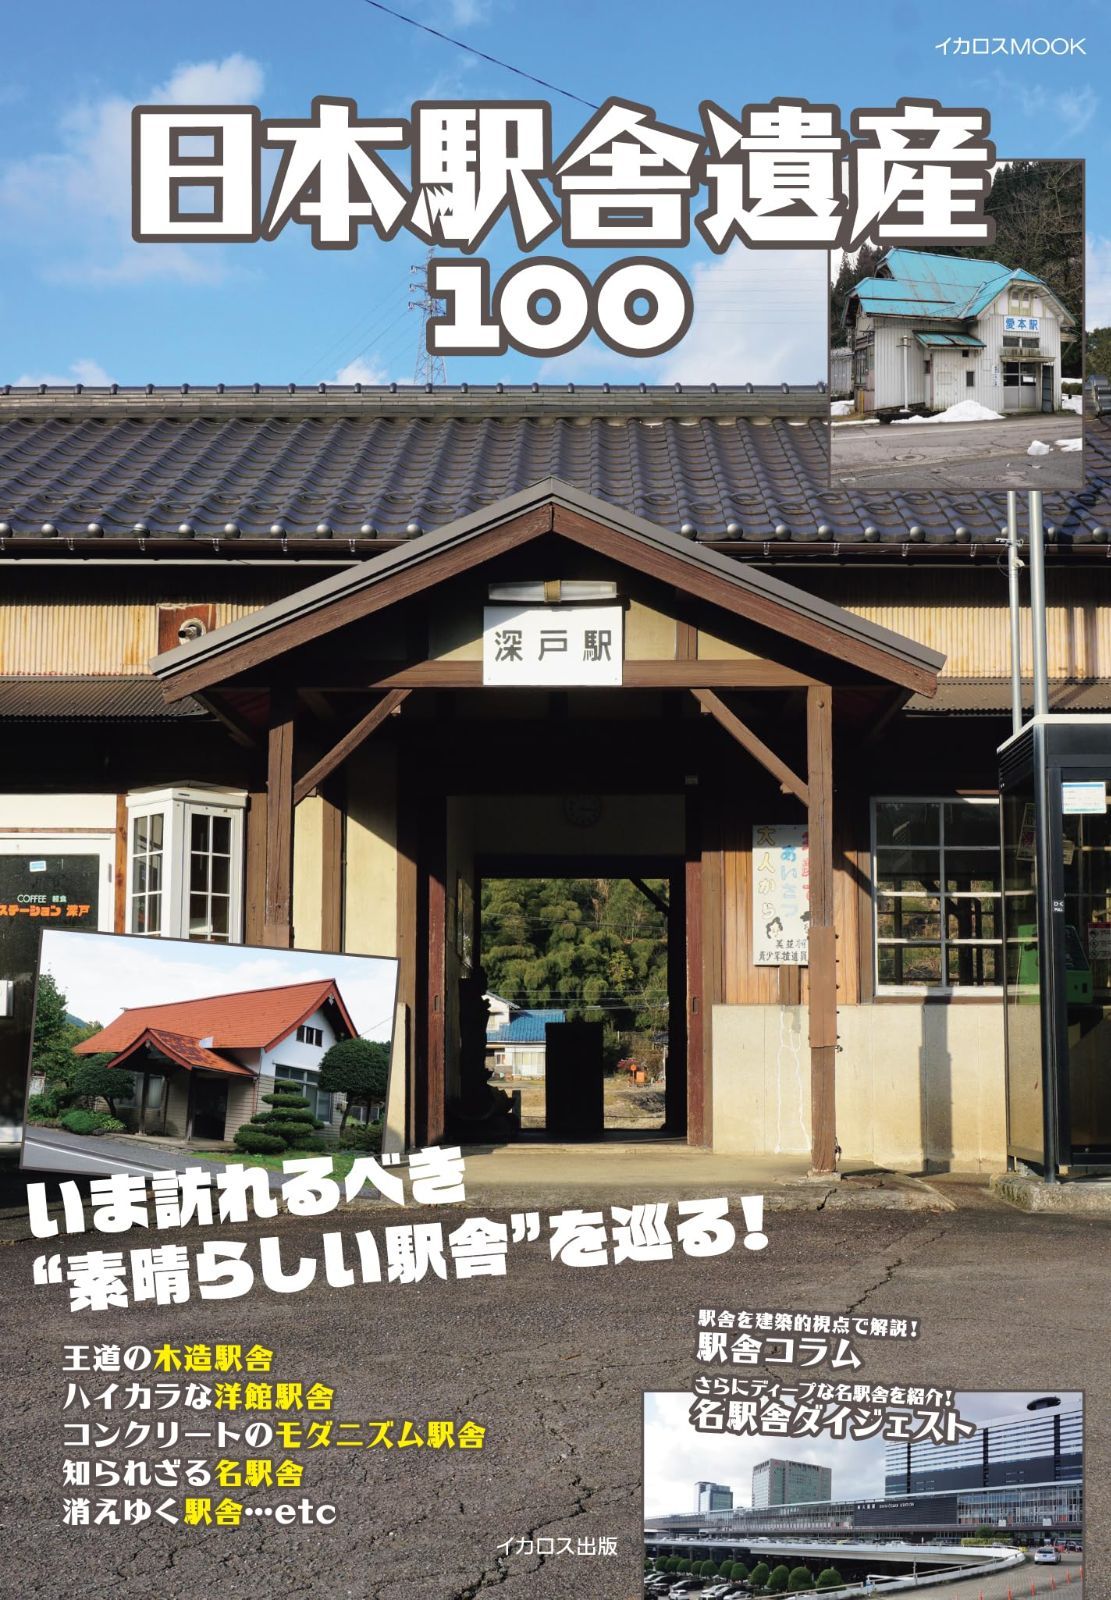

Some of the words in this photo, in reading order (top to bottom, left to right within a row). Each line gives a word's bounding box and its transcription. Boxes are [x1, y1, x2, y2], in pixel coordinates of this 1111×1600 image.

[1005, 318, 1038, 331] 愛本駅
[494, 629, 612, 662] 深戸駅
[756, 826, 776, 920] 大人から
[17, 894, 47, 904] COFFEE
